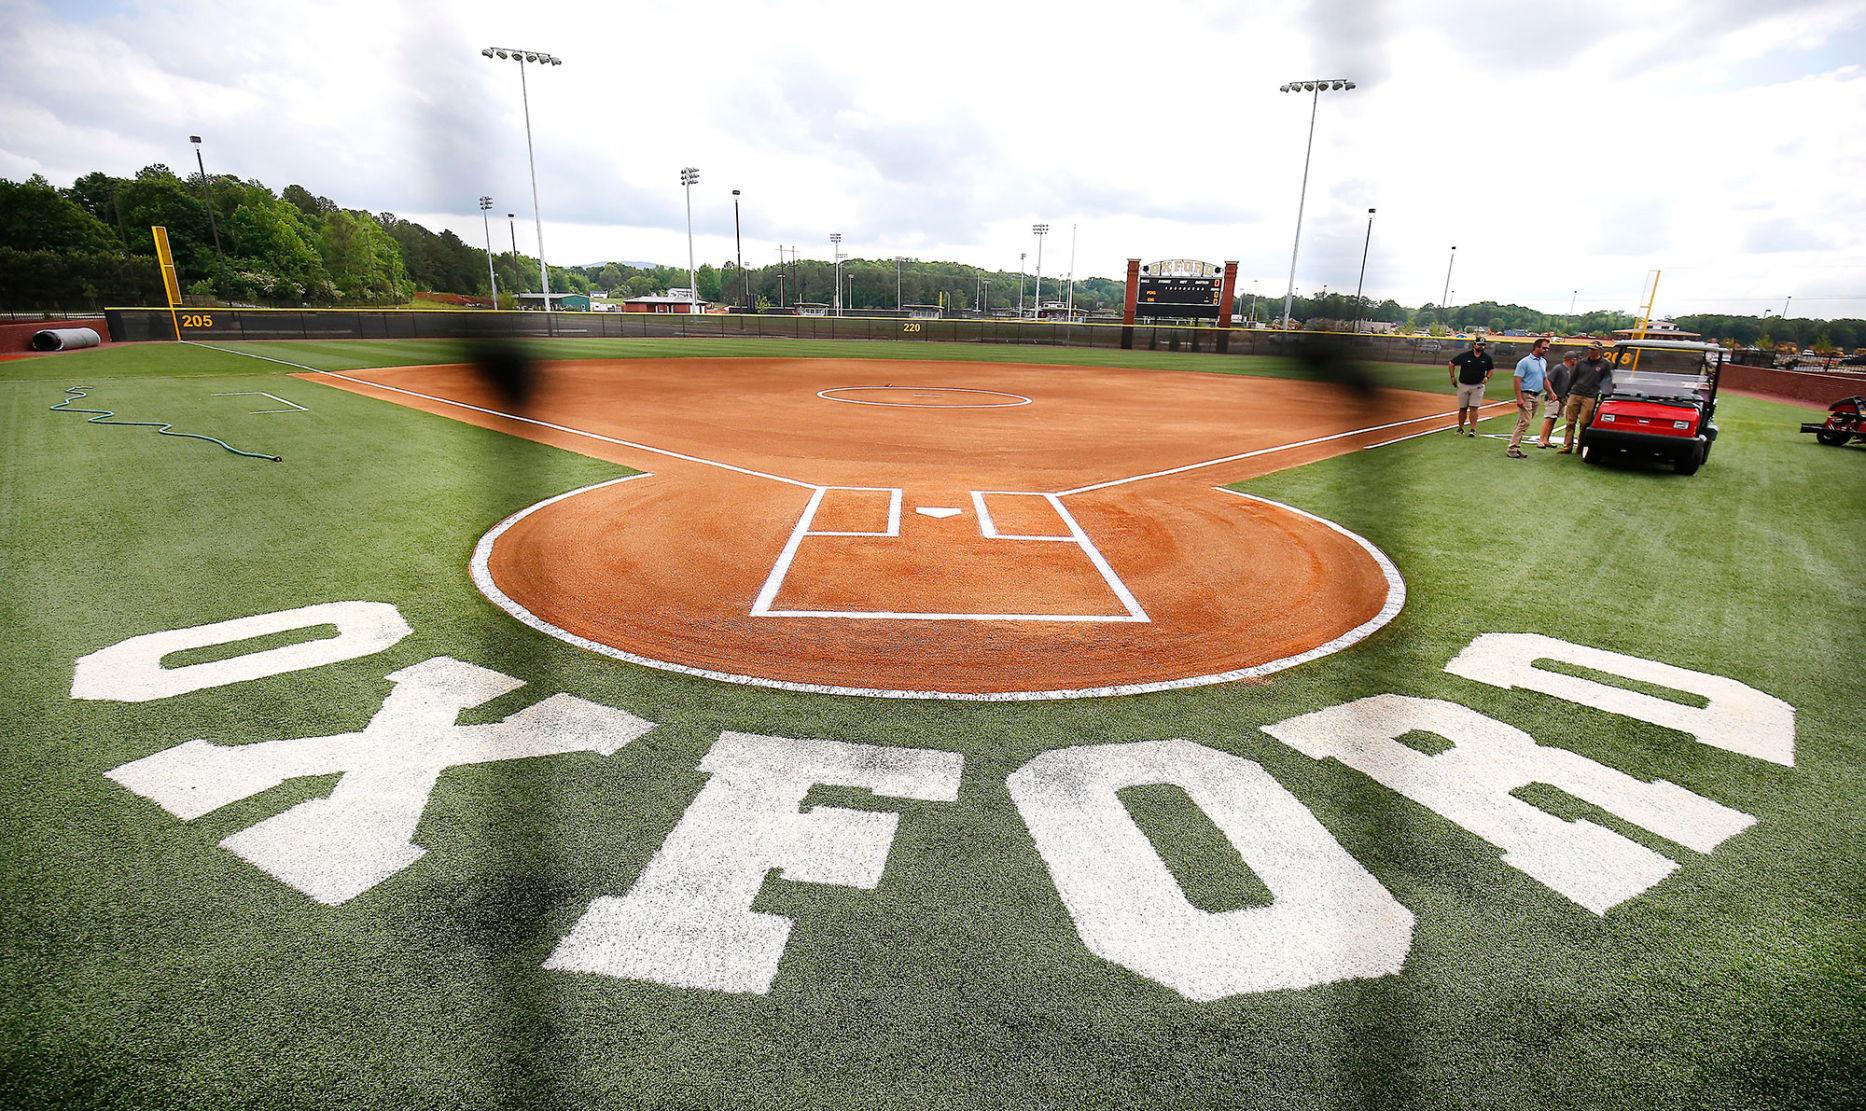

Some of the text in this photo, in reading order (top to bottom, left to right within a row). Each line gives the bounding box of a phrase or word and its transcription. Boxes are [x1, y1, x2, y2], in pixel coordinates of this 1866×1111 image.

[1151, 260, 1213, 275] OXFORD
[182, 315, 213, 327] 205
[903, 323, 920, 332] 220
[70, 600, 1797, 1003] OXFORD
